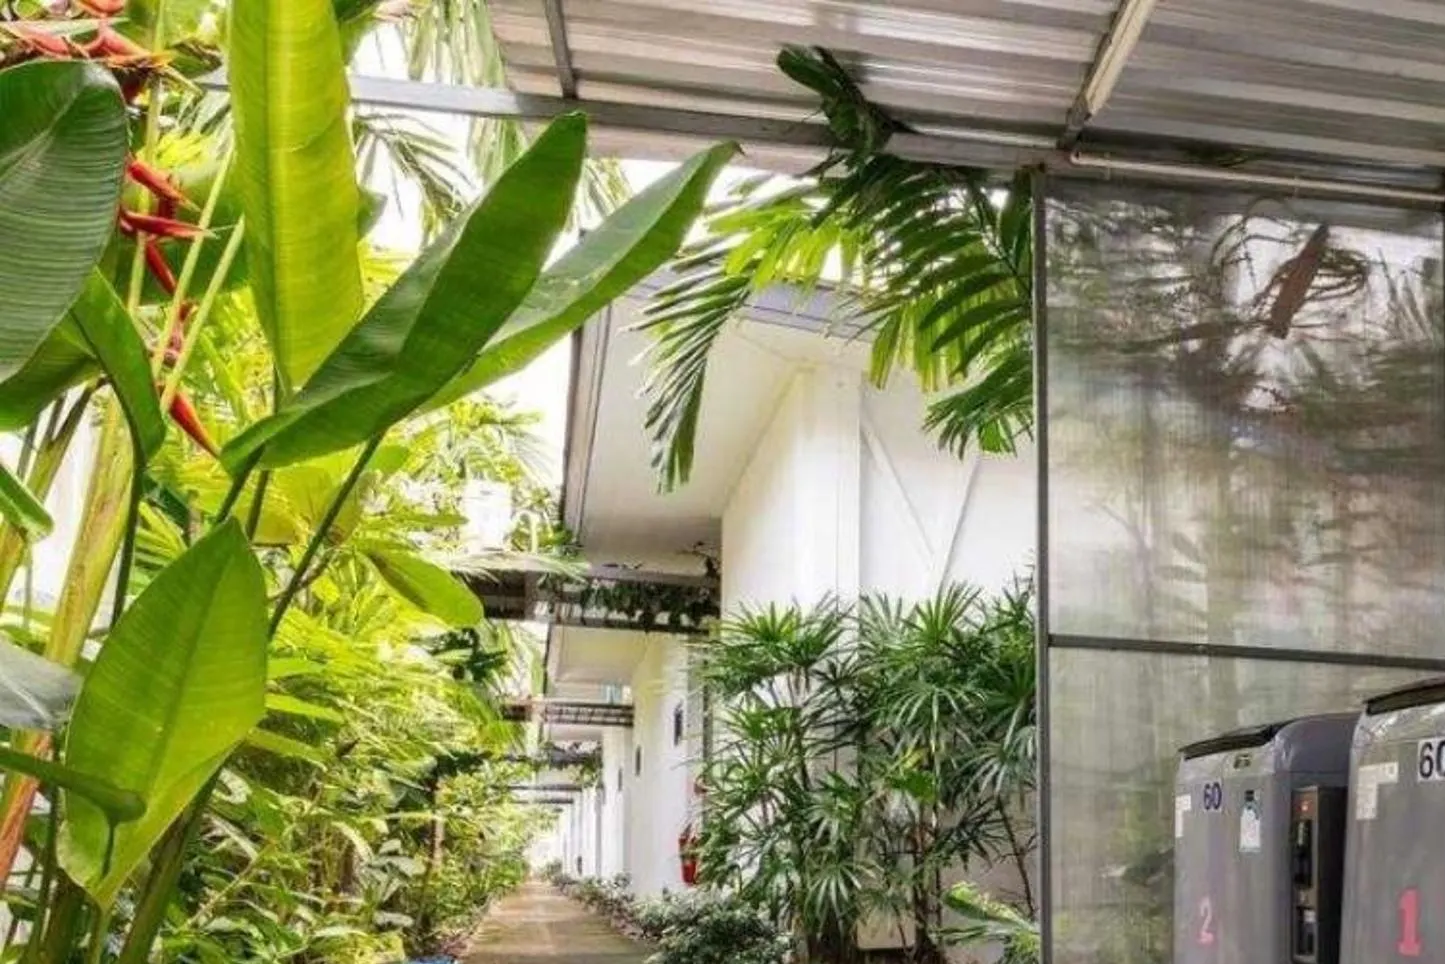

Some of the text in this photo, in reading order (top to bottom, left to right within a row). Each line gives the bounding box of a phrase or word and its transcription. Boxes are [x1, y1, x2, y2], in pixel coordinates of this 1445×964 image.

[1204, 782, 1222, 810] 60
[1199, 897, 1215, 944] 2
[1397, 888, 1421, 957] 1
